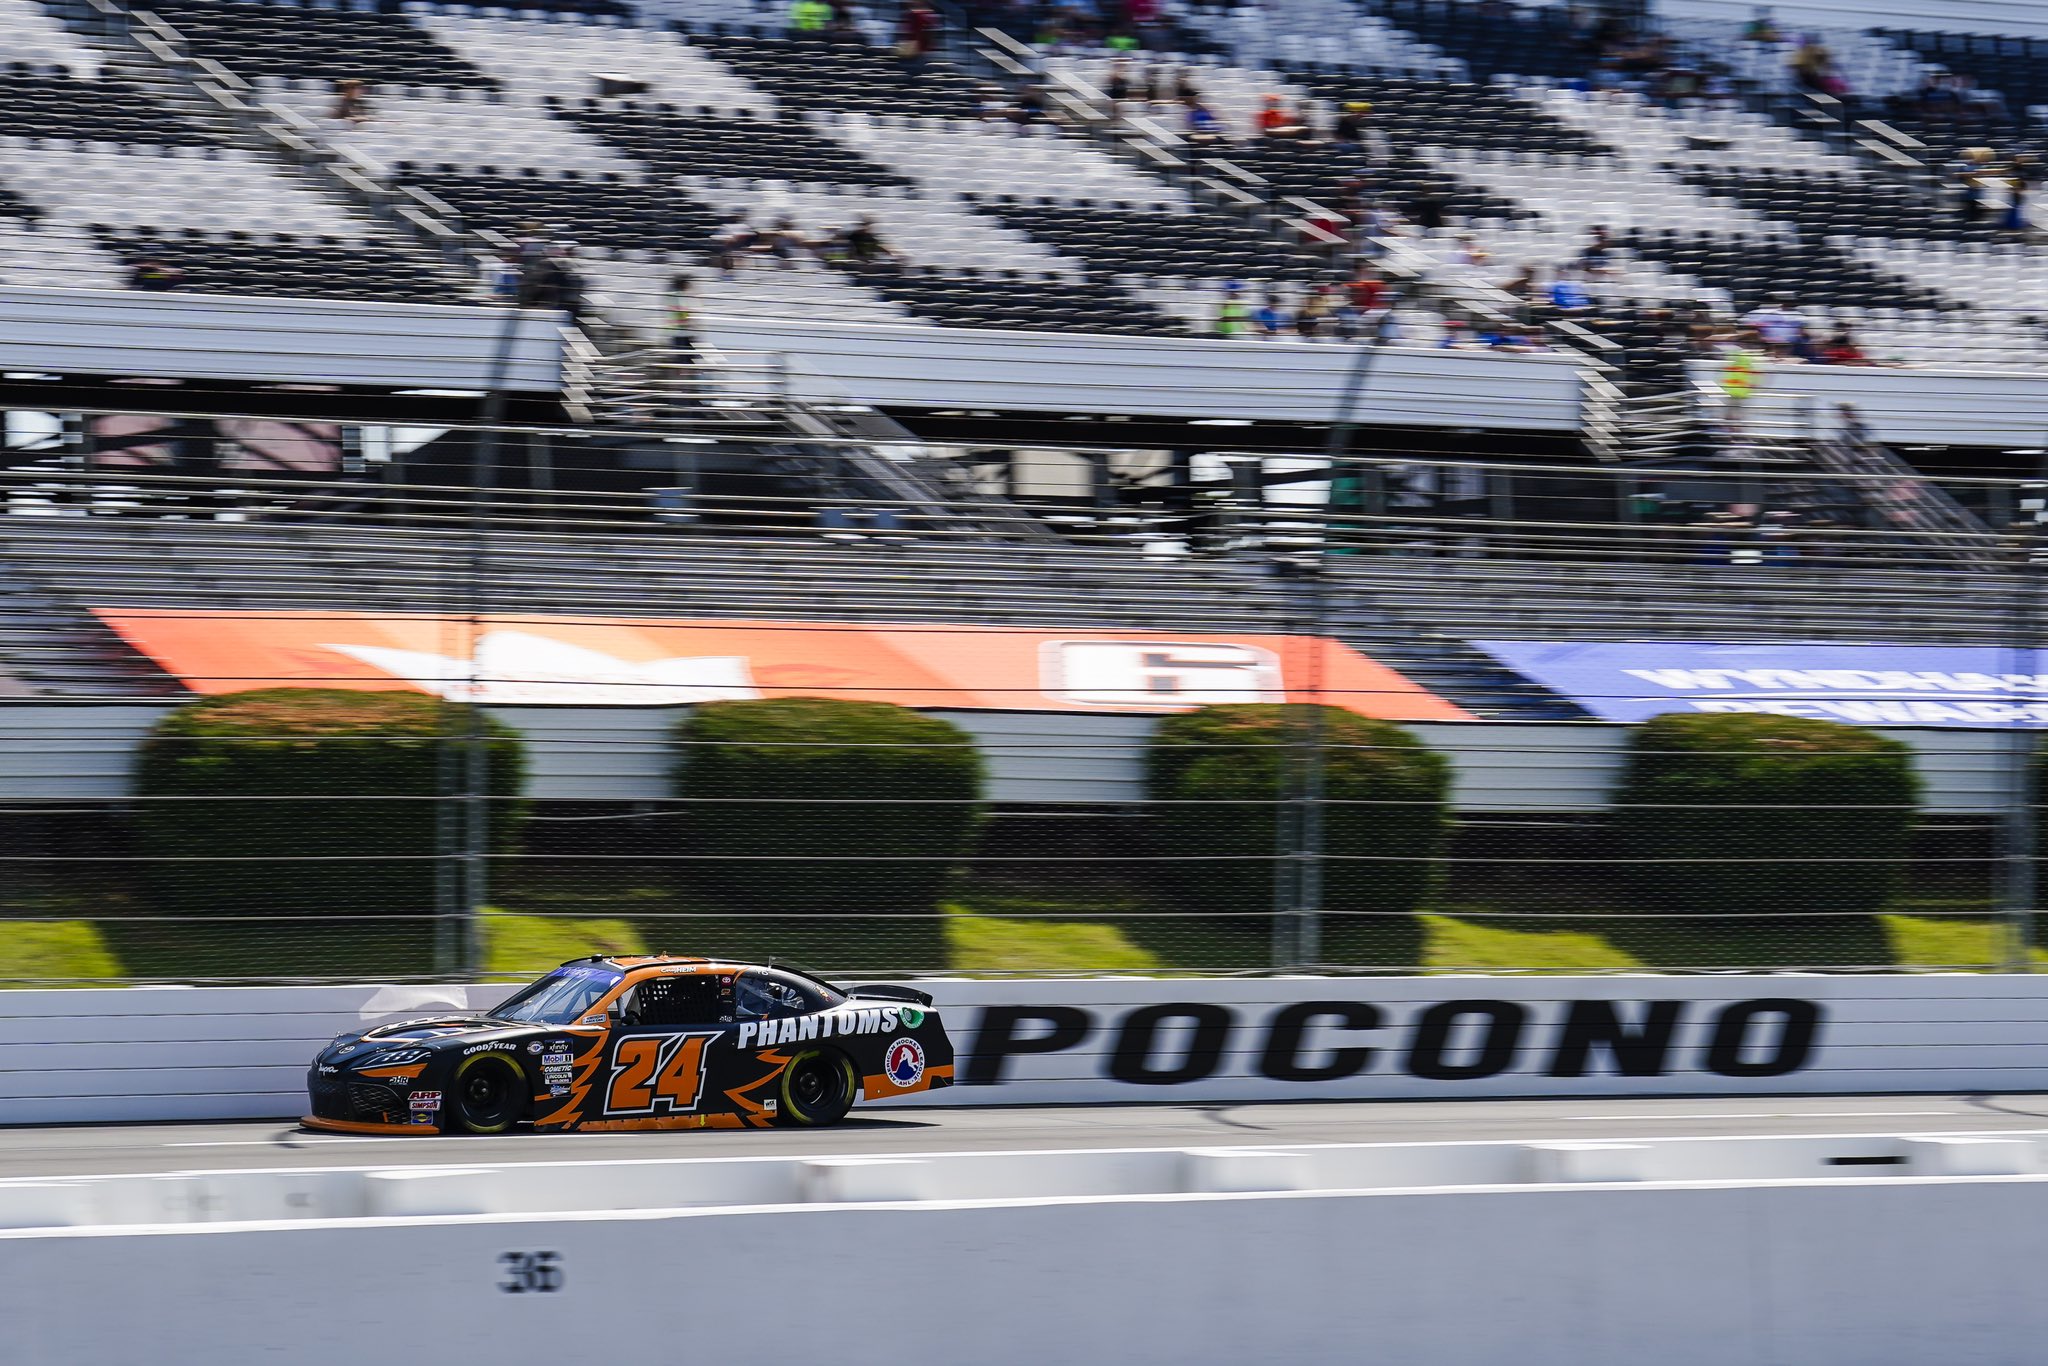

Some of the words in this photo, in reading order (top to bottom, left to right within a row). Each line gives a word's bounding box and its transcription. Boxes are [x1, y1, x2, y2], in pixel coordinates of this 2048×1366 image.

[463, 1041, 516, 1055] GOODYEAR
[737, 1007, 898, 1049] PHANTOMS
[896, 1039, 920, 1050] HOCKEY
[954, 998, 1826, 1085] POCONO
[544, 1055, 564, 1063] Mobil
[605, 1033, 718, 1113] 24
[498, 1251, 566, 1293] 36
